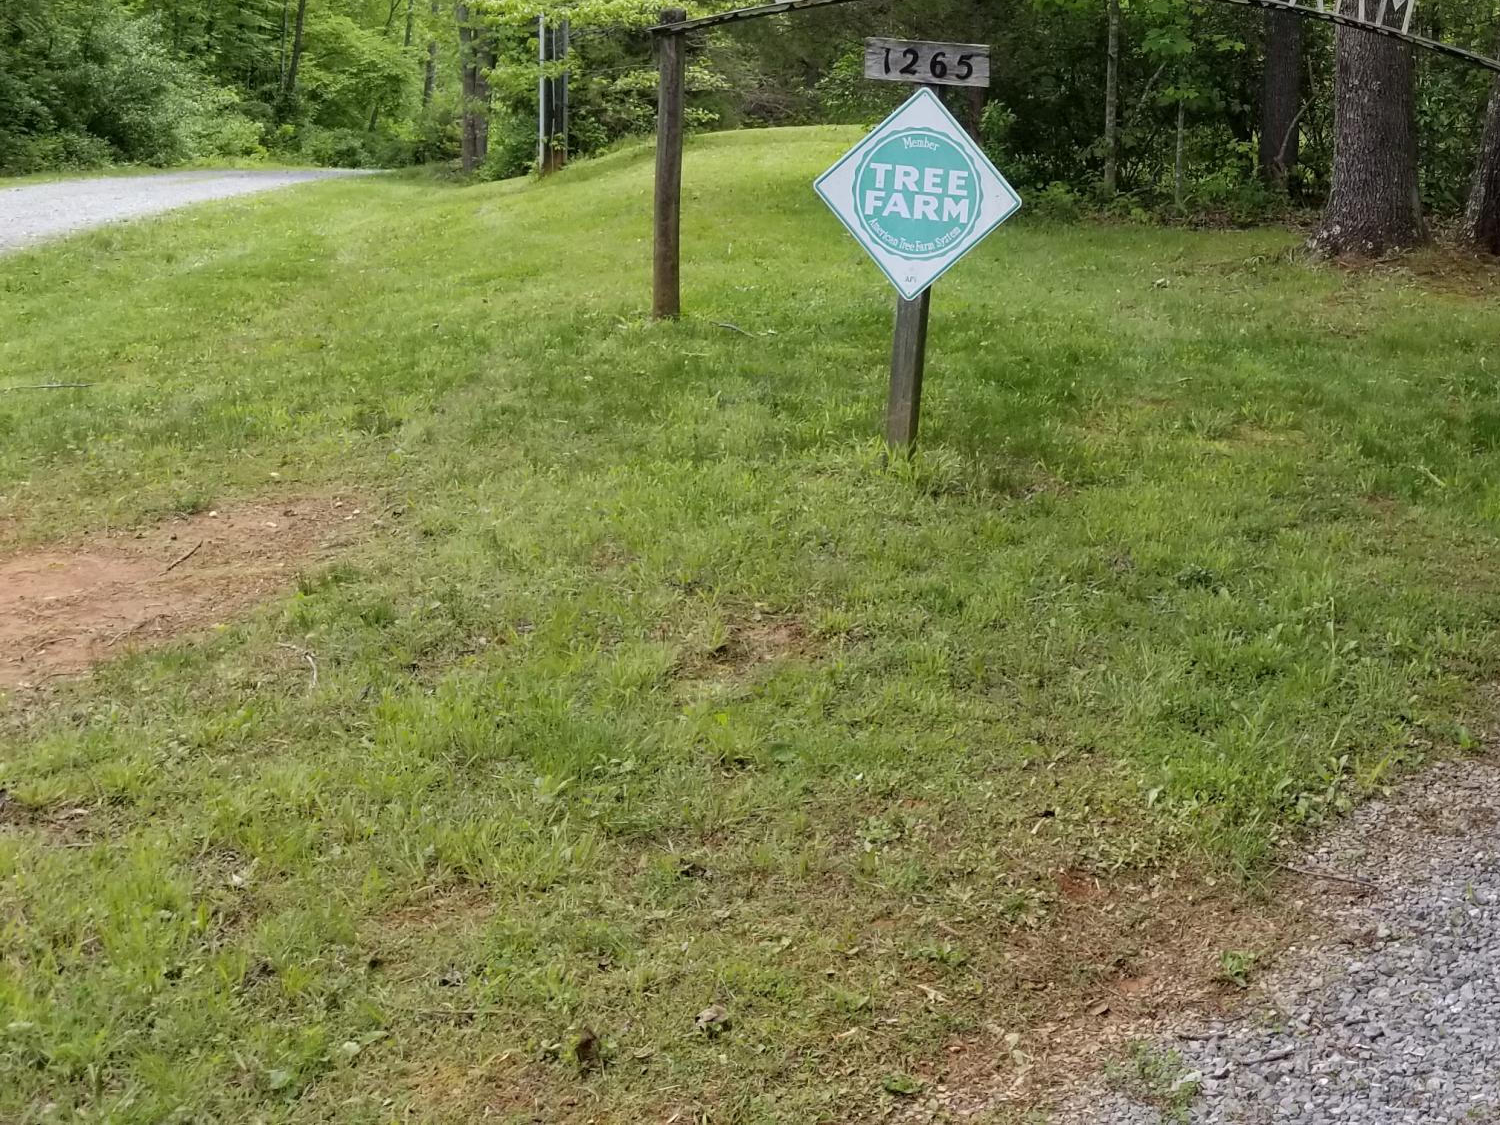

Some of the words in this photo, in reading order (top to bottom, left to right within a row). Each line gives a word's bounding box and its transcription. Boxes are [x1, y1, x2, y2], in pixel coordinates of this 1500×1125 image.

[884, 48, 974, 80] 1265
[902, 136, 939, 151] Member
[870, 163, 969, 195] TREE
[864, 191, 969, 223] FARM
[868, 218, 898, 246] American
[899, 237, 915, 251] Tree
[936, 226, 961, 248] System
